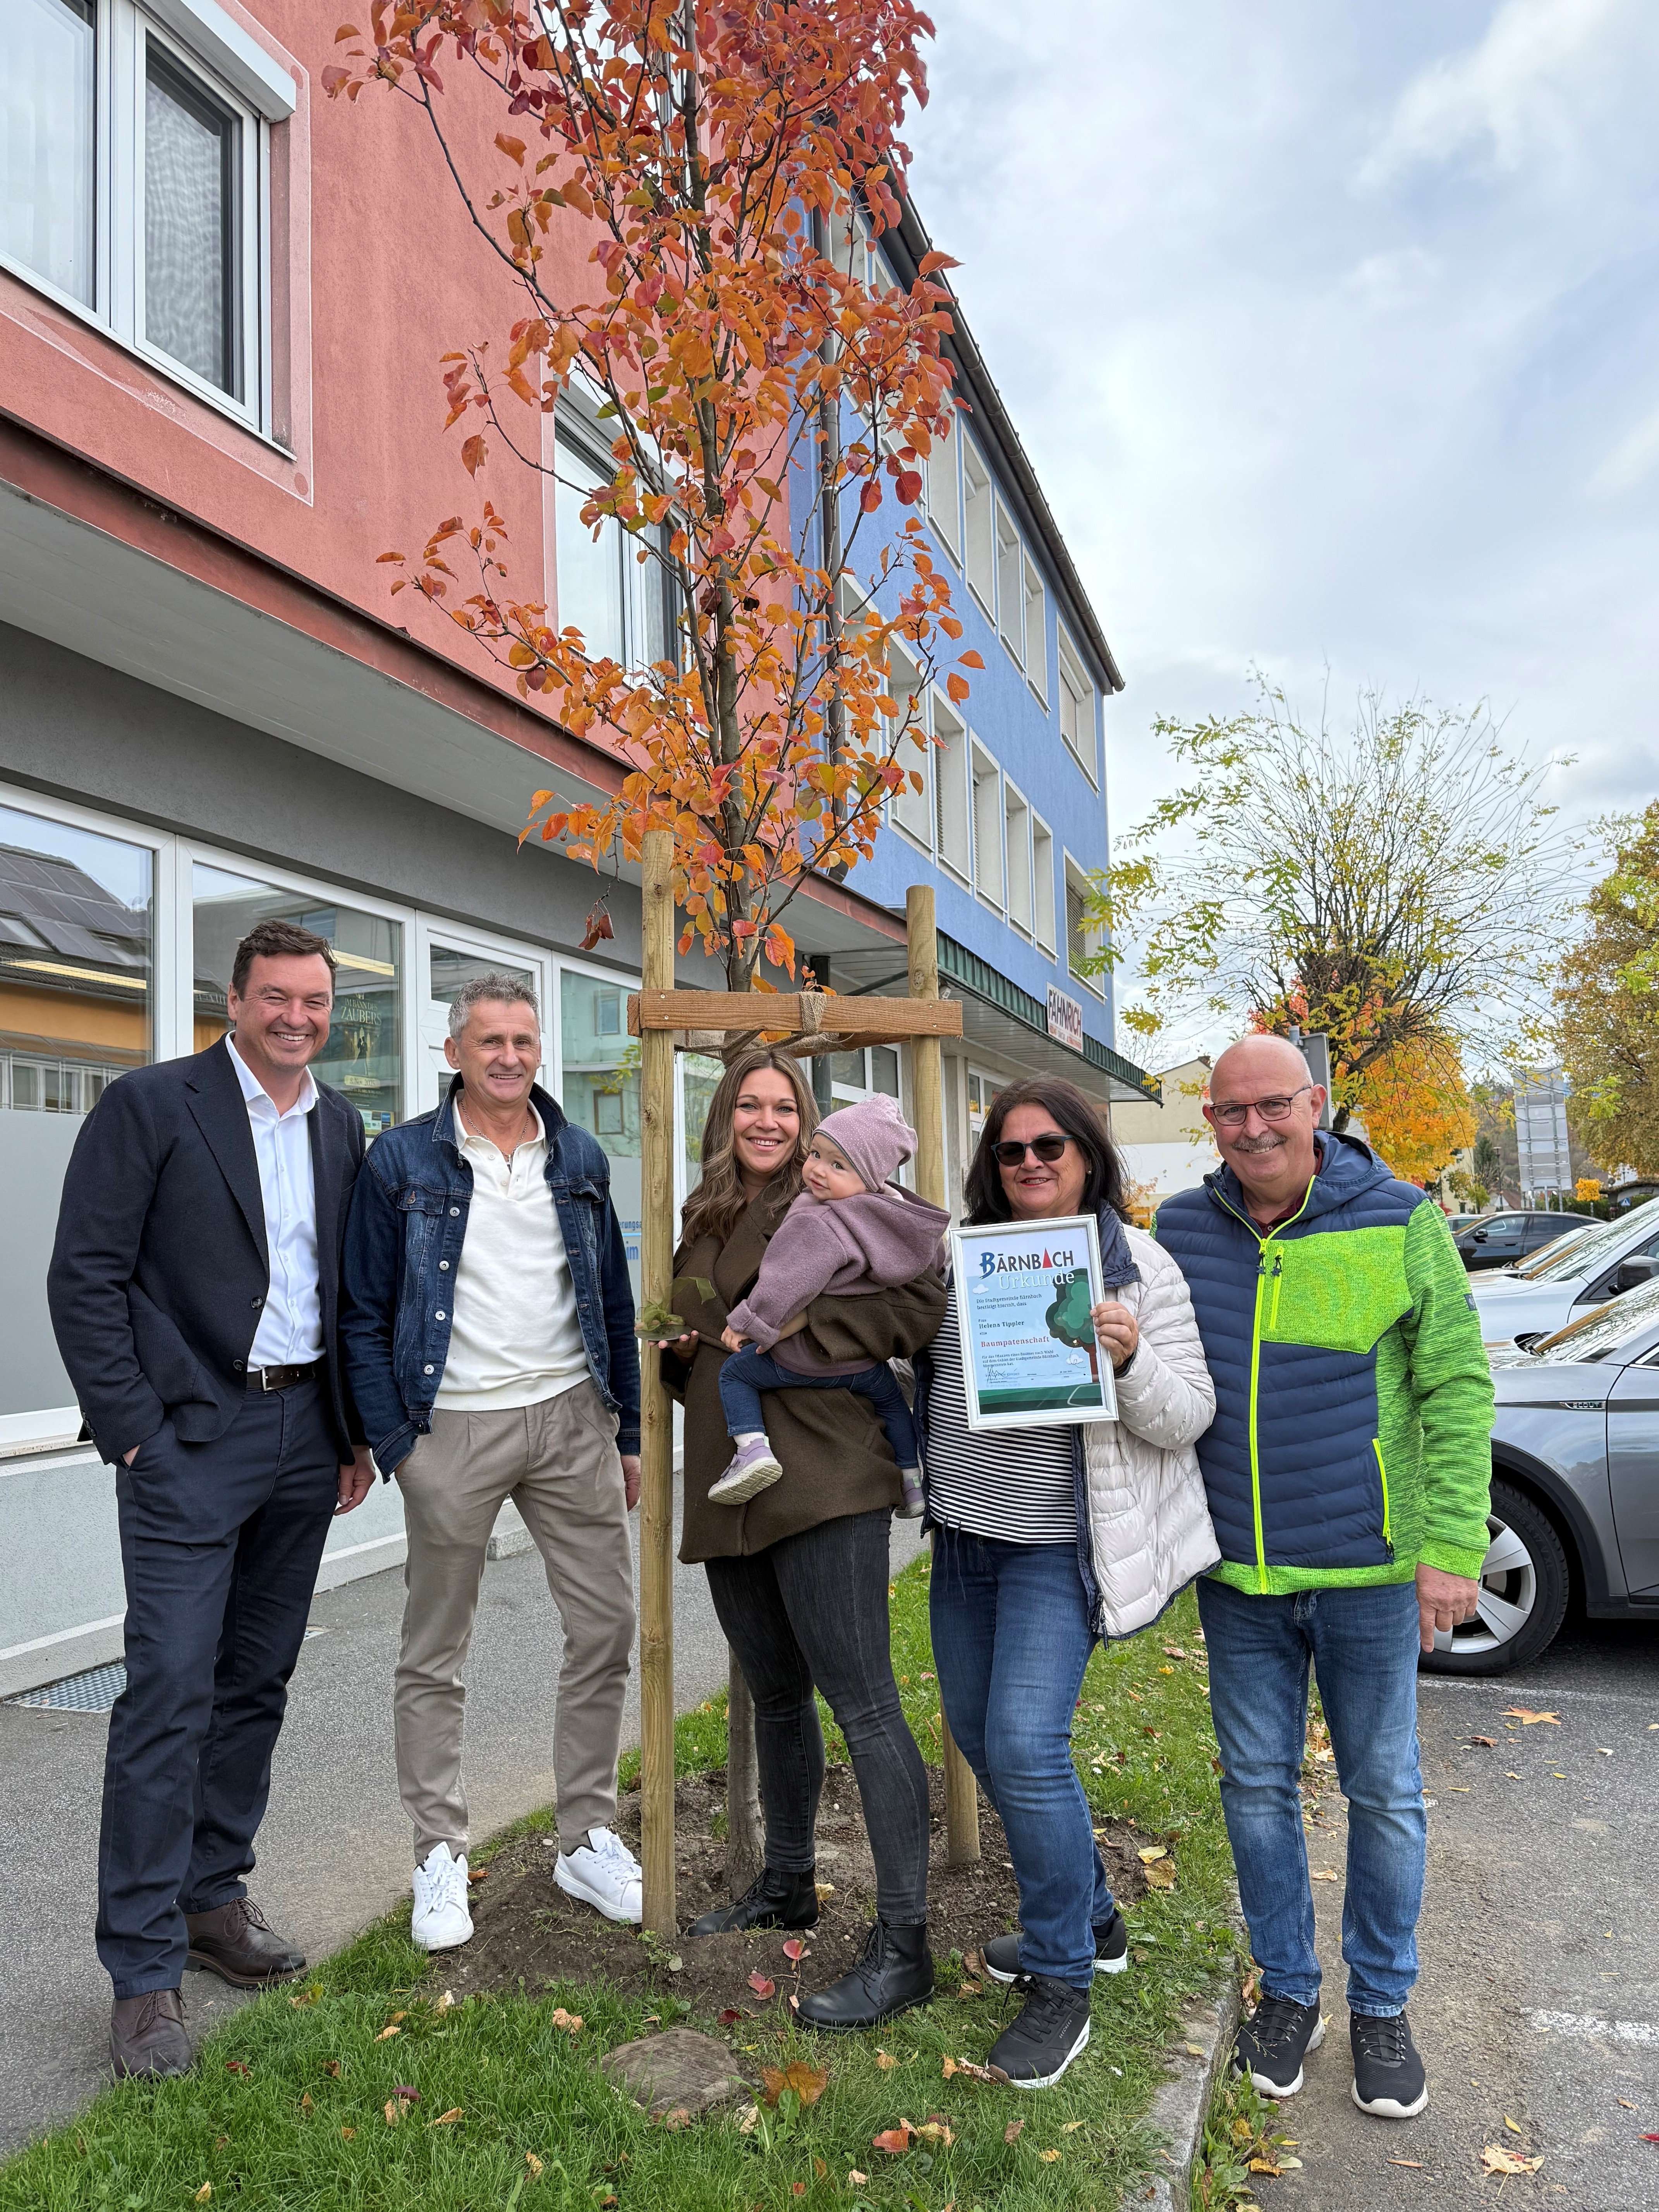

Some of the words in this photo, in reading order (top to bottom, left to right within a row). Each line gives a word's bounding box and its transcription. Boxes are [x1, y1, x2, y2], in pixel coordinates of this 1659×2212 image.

[341, 1006, 381, 1025] ZAUBERS
[1049, 989, 1082, 1038] FÄHNRICH
[999, 1269, 1075, 1290] Urkunde
[981, 1336, 1049, 1347] Baumpatenschaft
